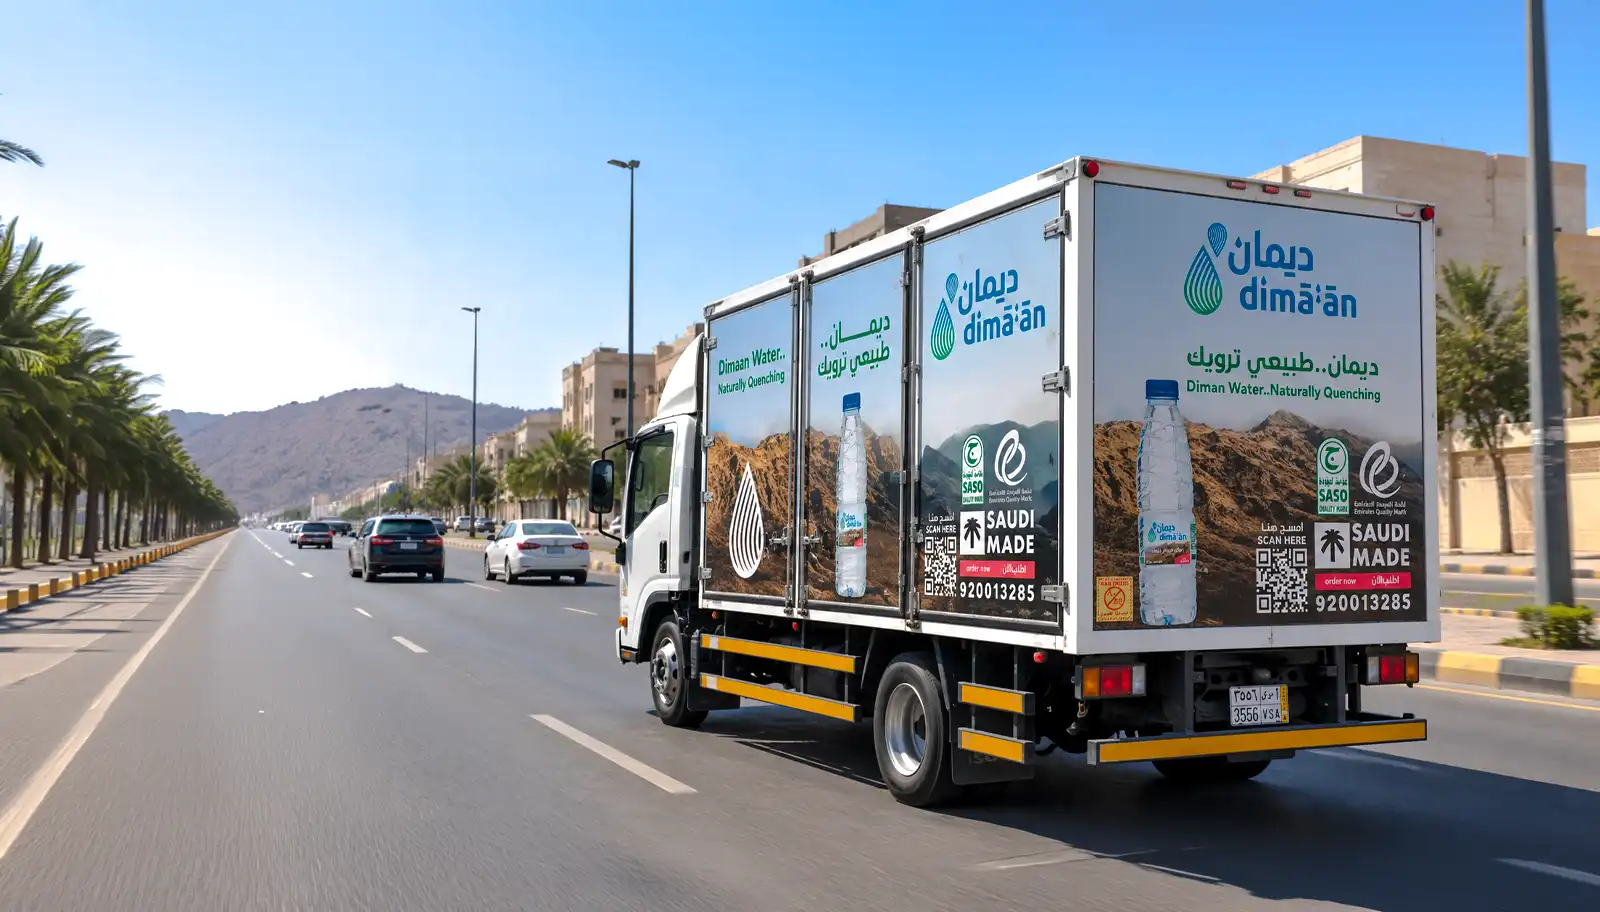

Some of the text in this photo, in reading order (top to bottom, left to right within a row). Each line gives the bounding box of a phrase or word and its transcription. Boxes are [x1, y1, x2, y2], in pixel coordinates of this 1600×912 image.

[1228, 230, 1314, 278] ديمان
[958, 268, 1018, 316] ديمان
[718, 354, 750, 376] Dimaan
[817, 340, 890, 380] طبيعي ترويك
[1186, 345, 1241, 374] ترويك
[718, 370, 785, 395] Naturally Quenching
[1186, 379, 1226, 395] Diman
[1323, 386, 1381, 403] Quenching
[962, 480, 984, 494] SASO
[1318, 488, 1348, 503] SASO
[925, 524, 957, 534] SCAN HERE
[987, 509, 1035, 530] SAUDI
[1257, 535, 1307, 545] SCAN HERE
[1352, 523, 1410, 542] SAUDI
[987, 534, 1035, 554] MADE
[1352, 547, 1410, 567] MADE
[966, 563, 991, 573] order now
[1325, 576, 1357, 585] order now
[960, 581, 1035, 602] 920013285
[1316, 593, 1411, 612] 920013285
[1233, 689, 1258, 702] ٣٥٥٦
[1233, 707, 1280, 722] 3556 VSA
